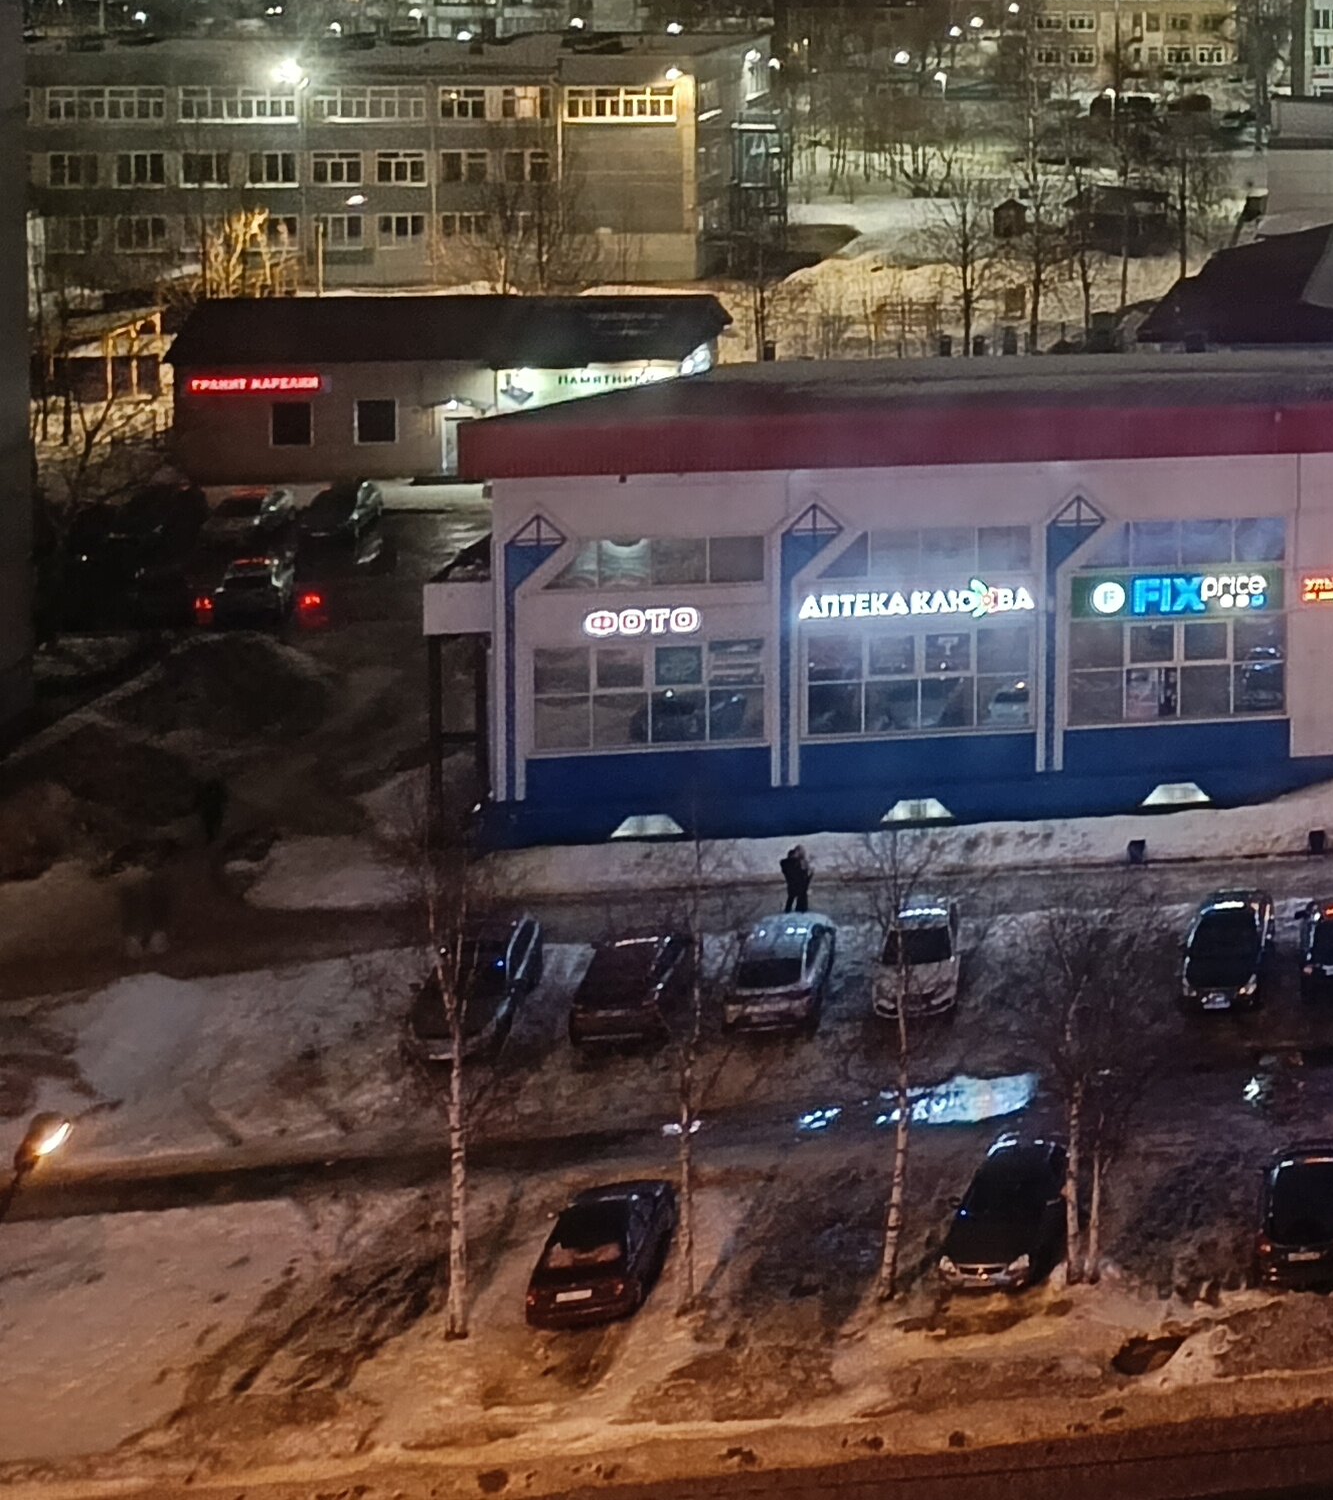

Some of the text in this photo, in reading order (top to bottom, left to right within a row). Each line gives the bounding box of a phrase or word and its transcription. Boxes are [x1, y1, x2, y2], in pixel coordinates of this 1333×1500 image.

[798, 590, 910, 620] АПТЕКА
[1133, 575, 1268, 613] FIX price
[584, 605, 700, 637] ФОТО
